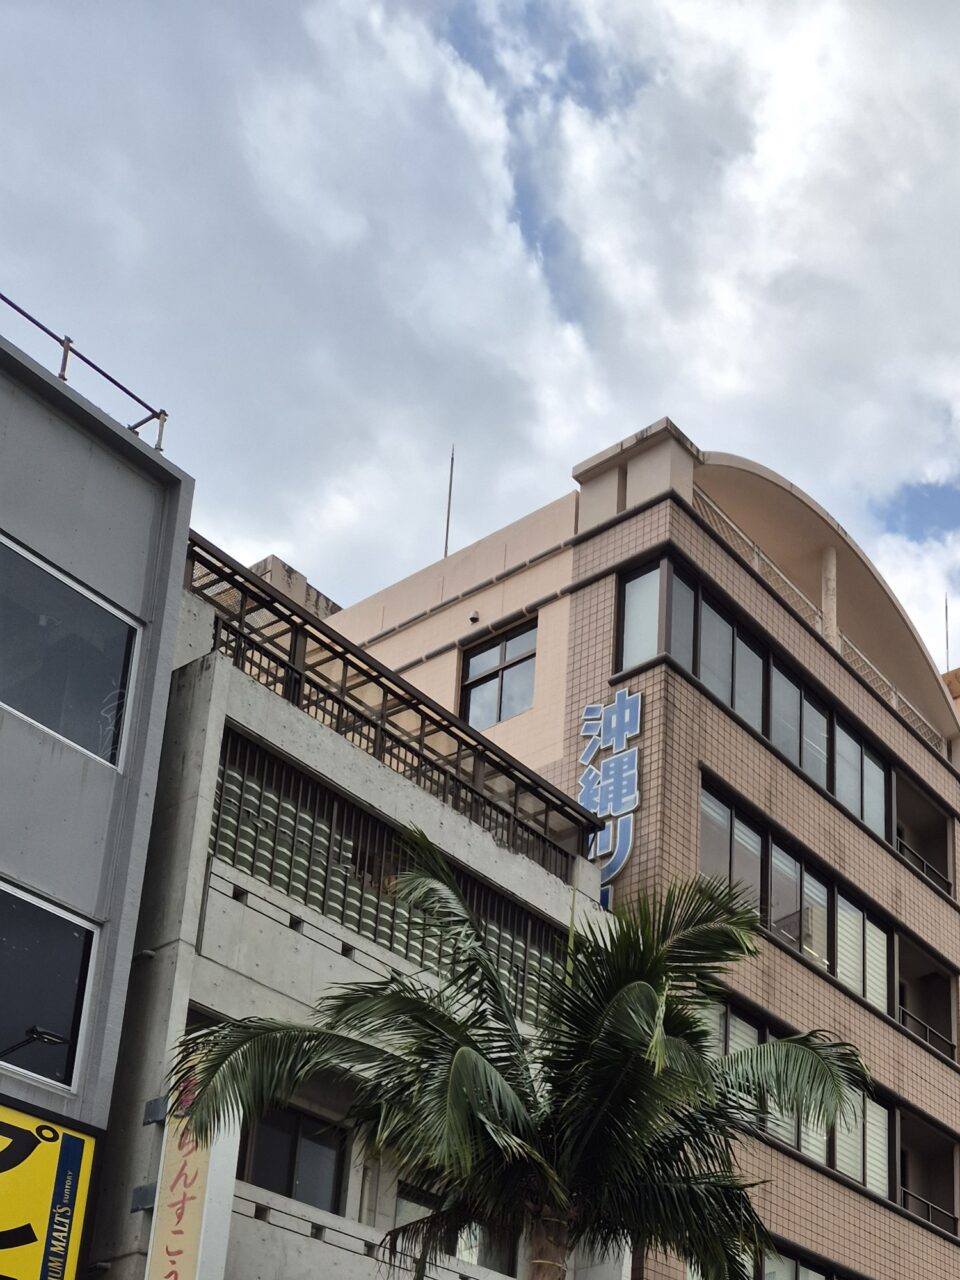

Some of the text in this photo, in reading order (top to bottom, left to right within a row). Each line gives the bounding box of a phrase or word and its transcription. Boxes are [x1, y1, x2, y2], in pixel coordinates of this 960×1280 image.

[578, 688, 642, 908] 沖縄ツ
[50, 1204, 72, 1255] MALT'S
